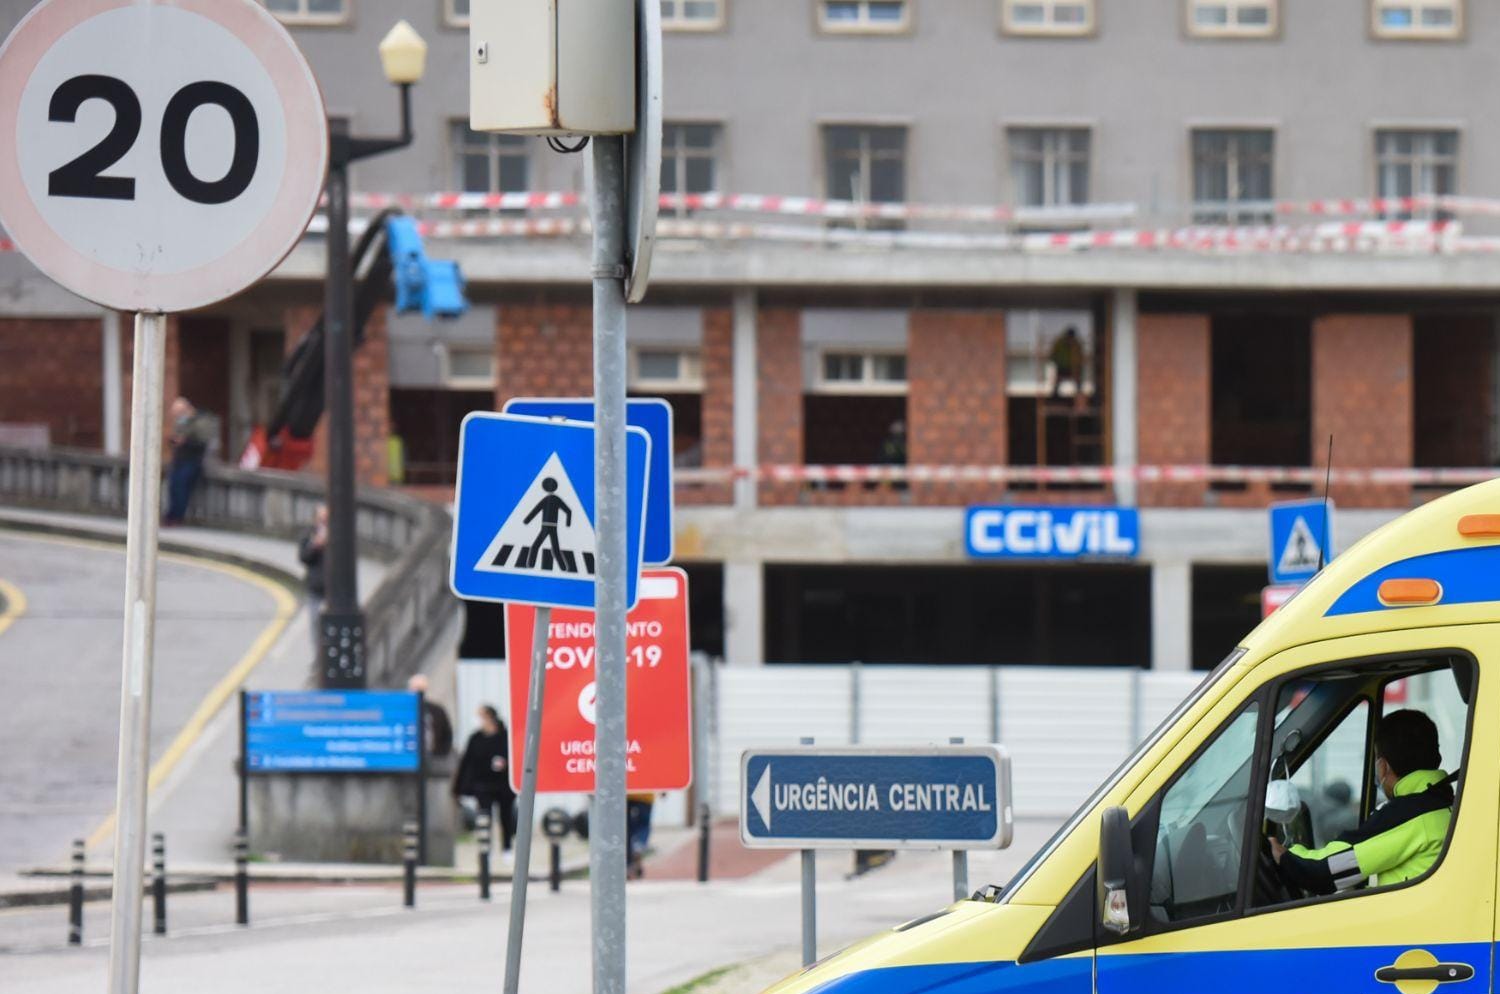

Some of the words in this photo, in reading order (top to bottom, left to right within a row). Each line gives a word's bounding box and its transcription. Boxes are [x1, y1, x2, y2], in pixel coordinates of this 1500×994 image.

[47, 73, 260, 205] 20
[774, 776, 880, 811] URGÊNCIA
[888, 783, 991, 812] CENTRAL
